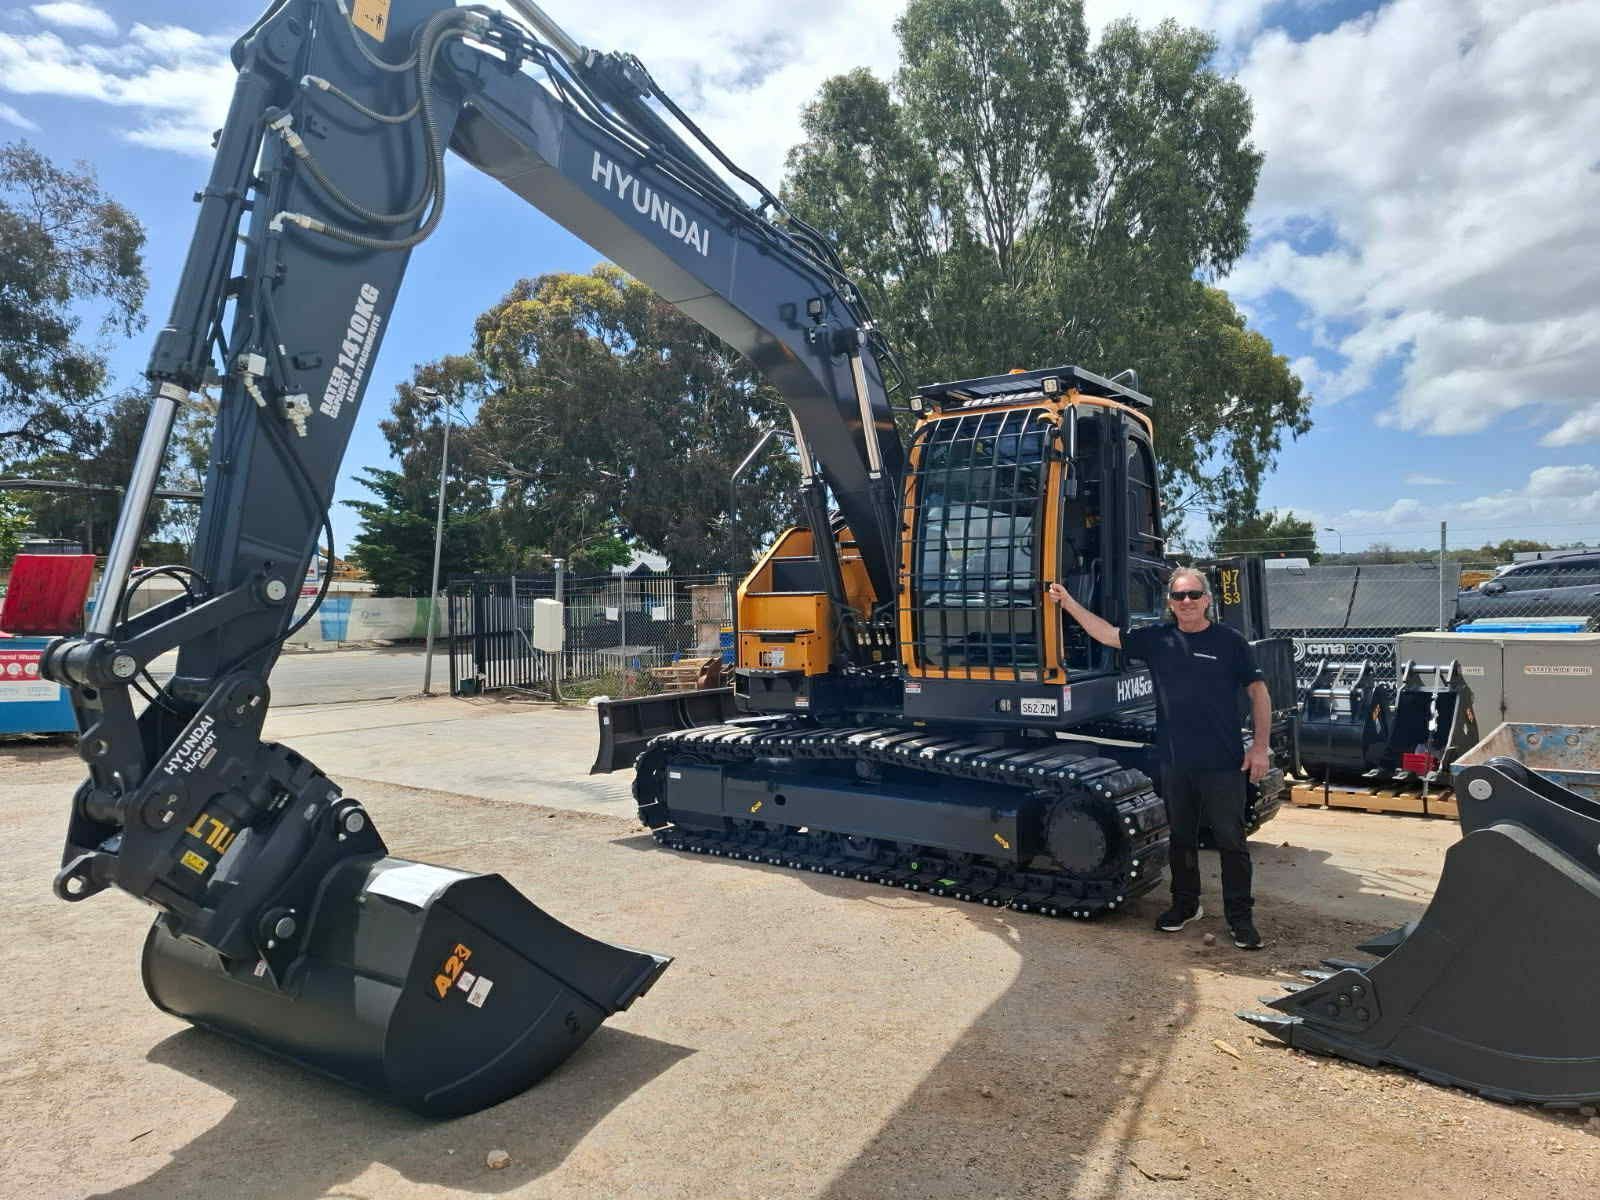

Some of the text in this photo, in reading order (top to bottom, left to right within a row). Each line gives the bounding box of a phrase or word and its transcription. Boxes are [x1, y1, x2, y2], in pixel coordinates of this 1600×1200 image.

[591, 151, 709, 257] HYUNDAI
[337, 283, 380, 369] 1410KG
[319, 366, 344, 416] RATED
[163, 715, 216, 775] HYUNDAI
